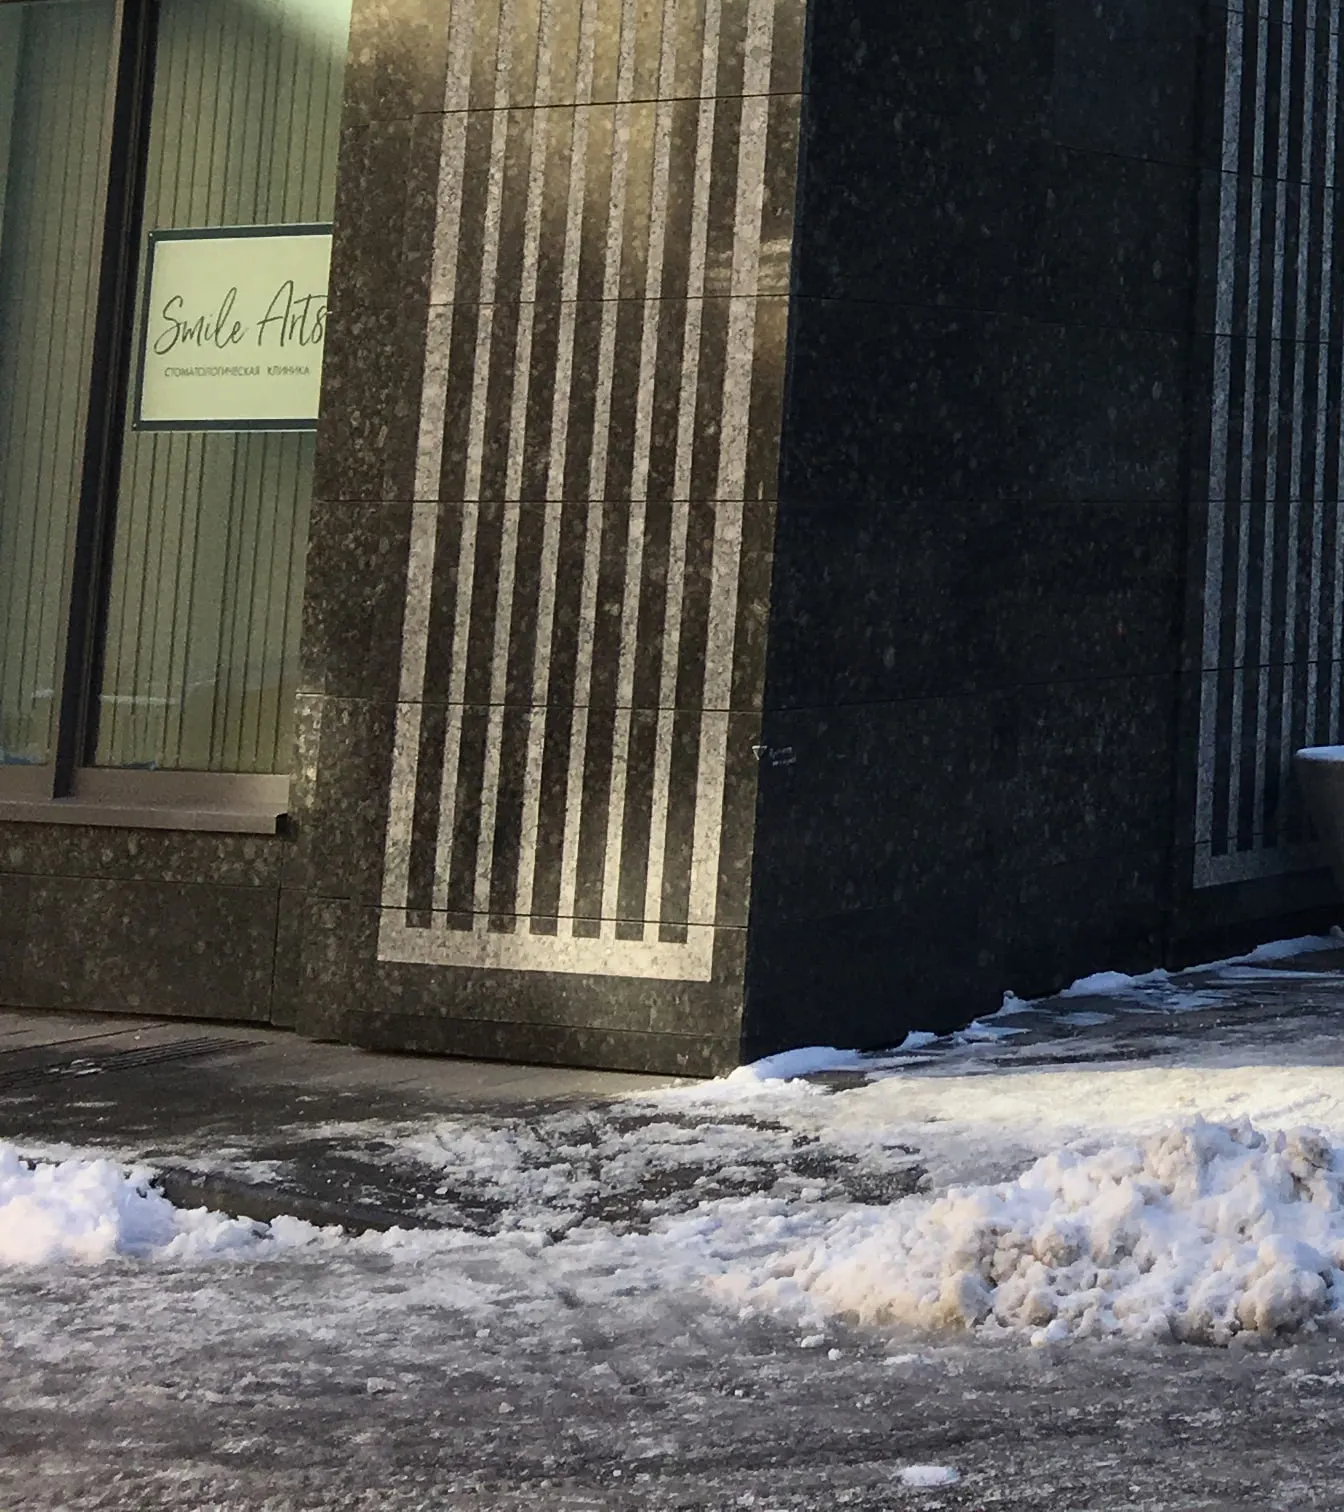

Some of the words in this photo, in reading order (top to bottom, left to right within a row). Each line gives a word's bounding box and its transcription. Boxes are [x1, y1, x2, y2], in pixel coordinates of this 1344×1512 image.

[154, 287, 246, 356] Smile
[257, 279, 328, 348] Arts
[267, 366, 310, 376] КЛИНИКА
